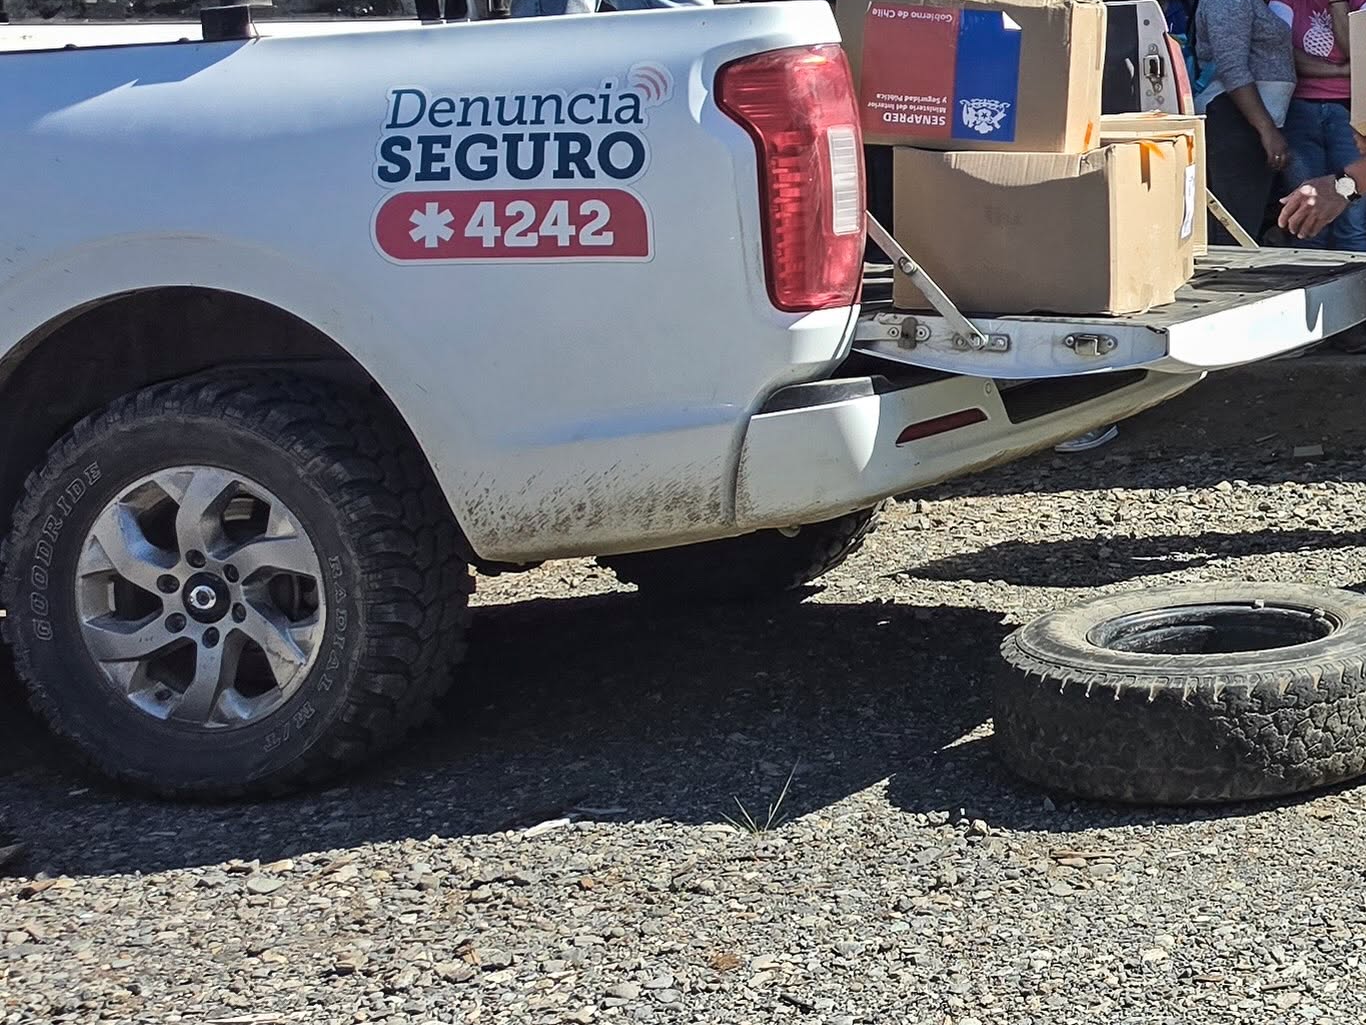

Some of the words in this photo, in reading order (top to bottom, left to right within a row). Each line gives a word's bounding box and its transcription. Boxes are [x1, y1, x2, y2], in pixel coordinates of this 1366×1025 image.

[872, 7, 896, 18] Chile
[897, 9, 909, 19] de
[910, 11, 953, 23] Gobierno
[904, 95, 940, 104] Seguridad
[385, 82, 644, 130] Denuncia
[867, 101, 895, 110] Interior
[896, 103, 908, 112] del
[909, 104, 947, 114] Ministerio
[883, 112, 947, 126] SENAPRED
[377, 130, 646, 183] SEGURO
[30, 461, 101, 641] GOODRIDE
[317, 555, 349, 692] RADIAL
